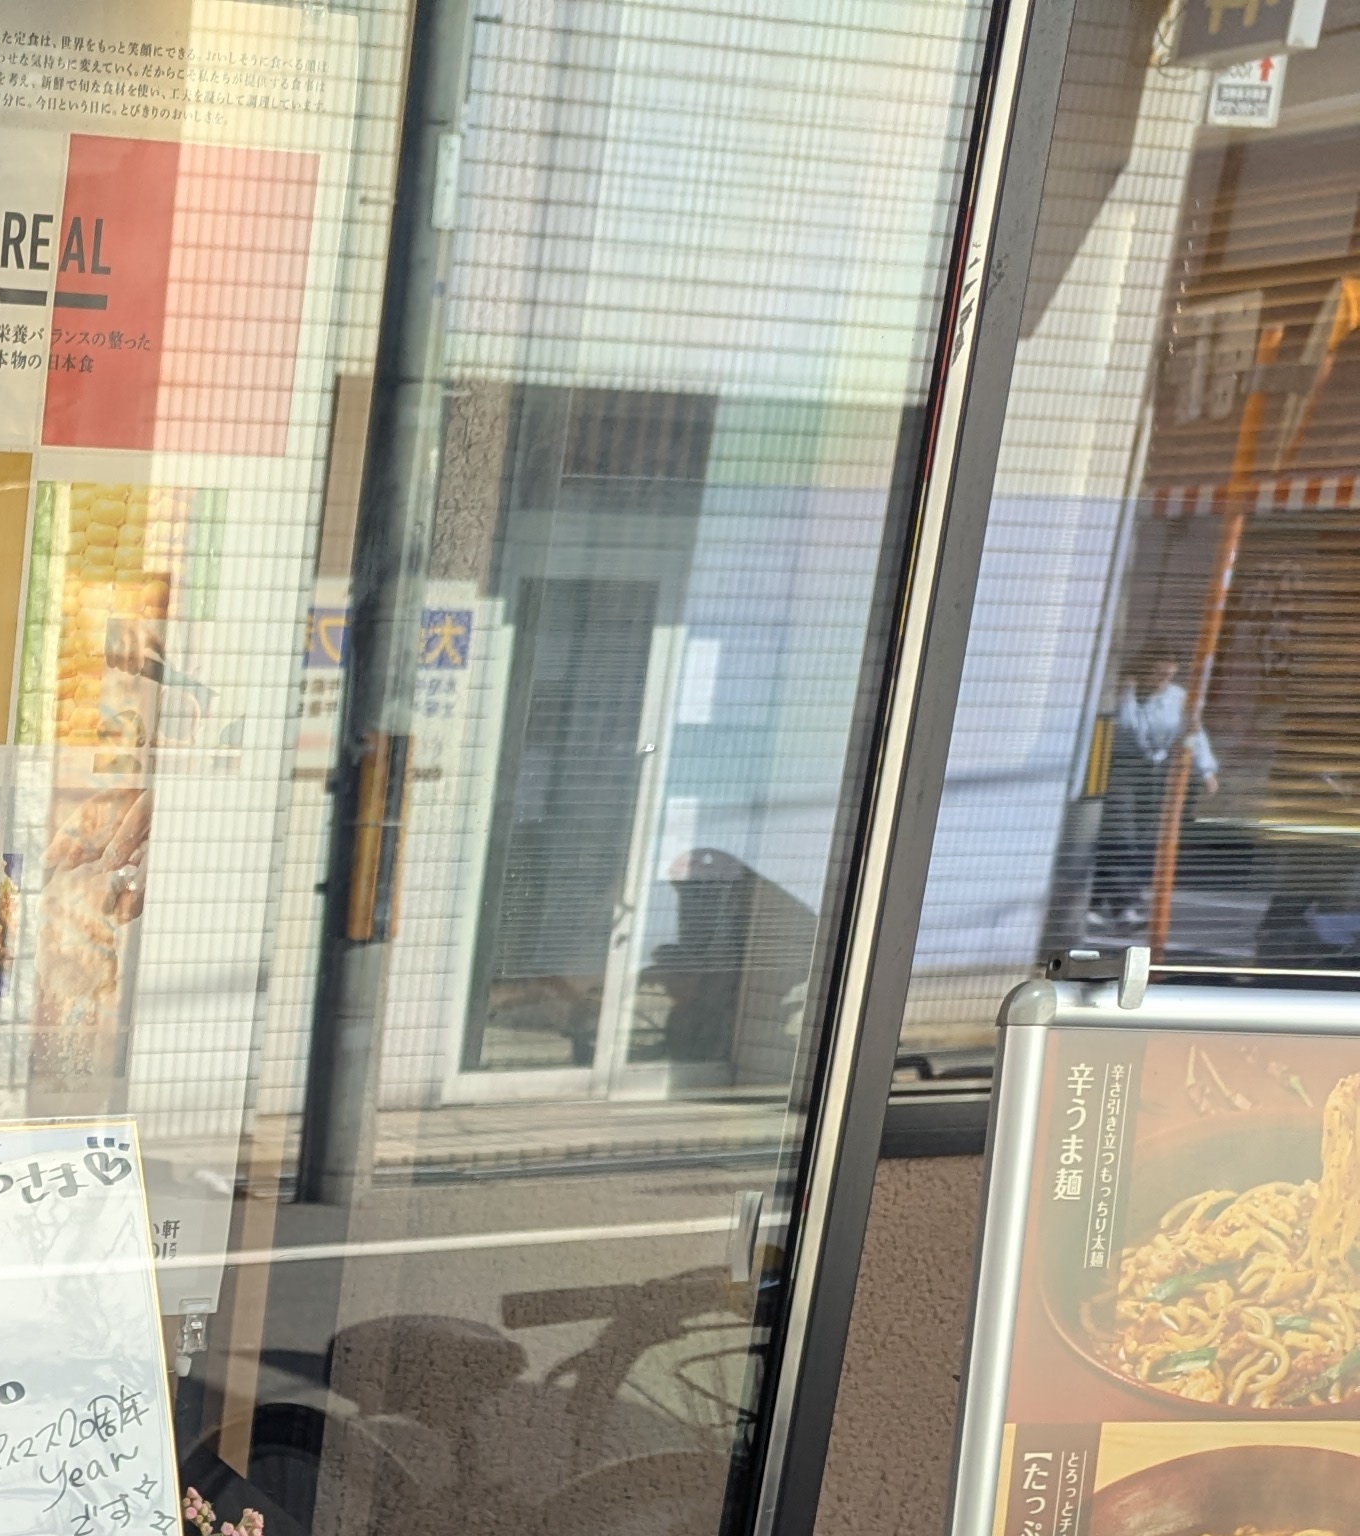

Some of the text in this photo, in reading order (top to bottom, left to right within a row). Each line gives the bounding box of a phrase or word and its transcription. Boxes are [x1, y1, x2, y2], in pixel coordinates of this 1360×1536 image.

[1053, 1063, 1095, 1201] 辛うま麺
[1089, 1064, 1125, 1268] 辛さ引き立つもっちり太麺
